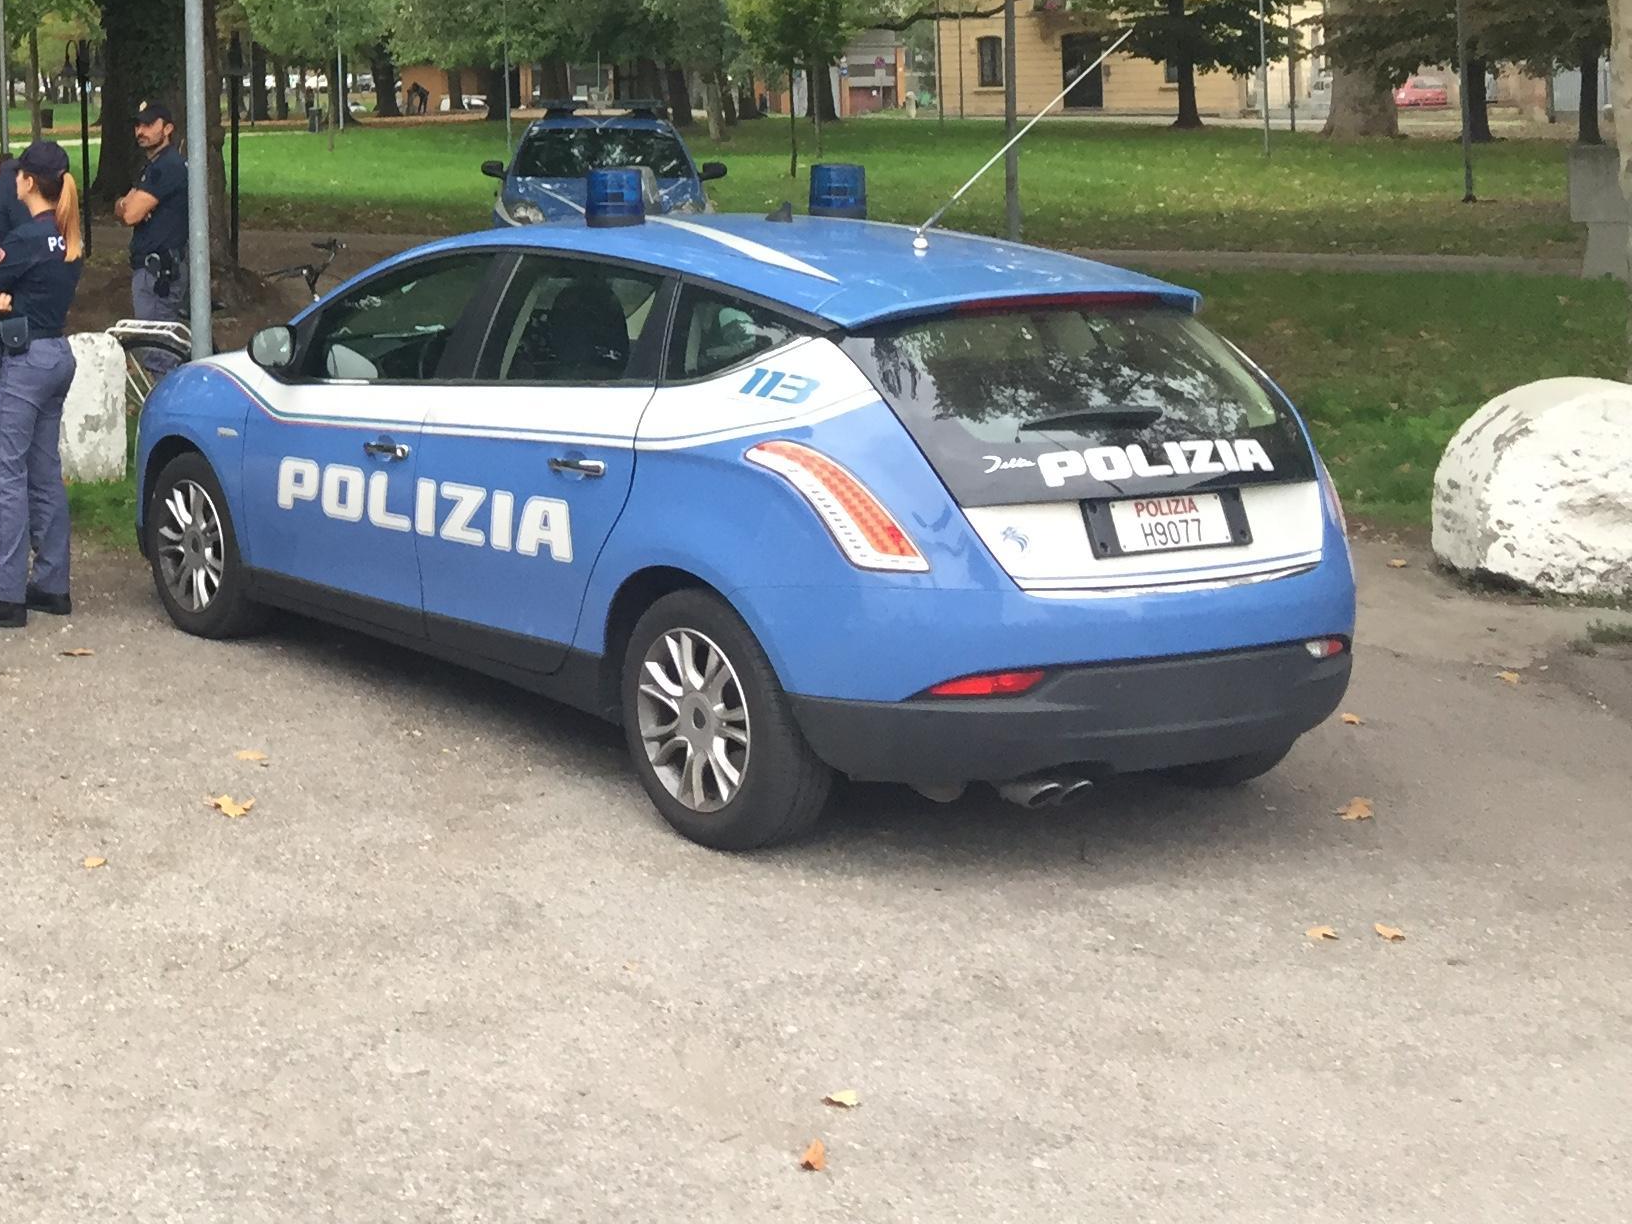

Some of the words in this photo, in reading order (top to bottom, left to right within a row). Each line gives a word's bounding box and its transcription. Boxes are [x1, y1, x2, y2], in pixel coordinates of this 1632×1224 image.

[739, 368, 820, 404] 113
[1037, 439, 1274, 487] POLIZIA
[277, 456, 574, 563] POLIZIA
[1134, 498, 1199, 518] POLIZIA
[1141, 518, 1202, 547] H9077
